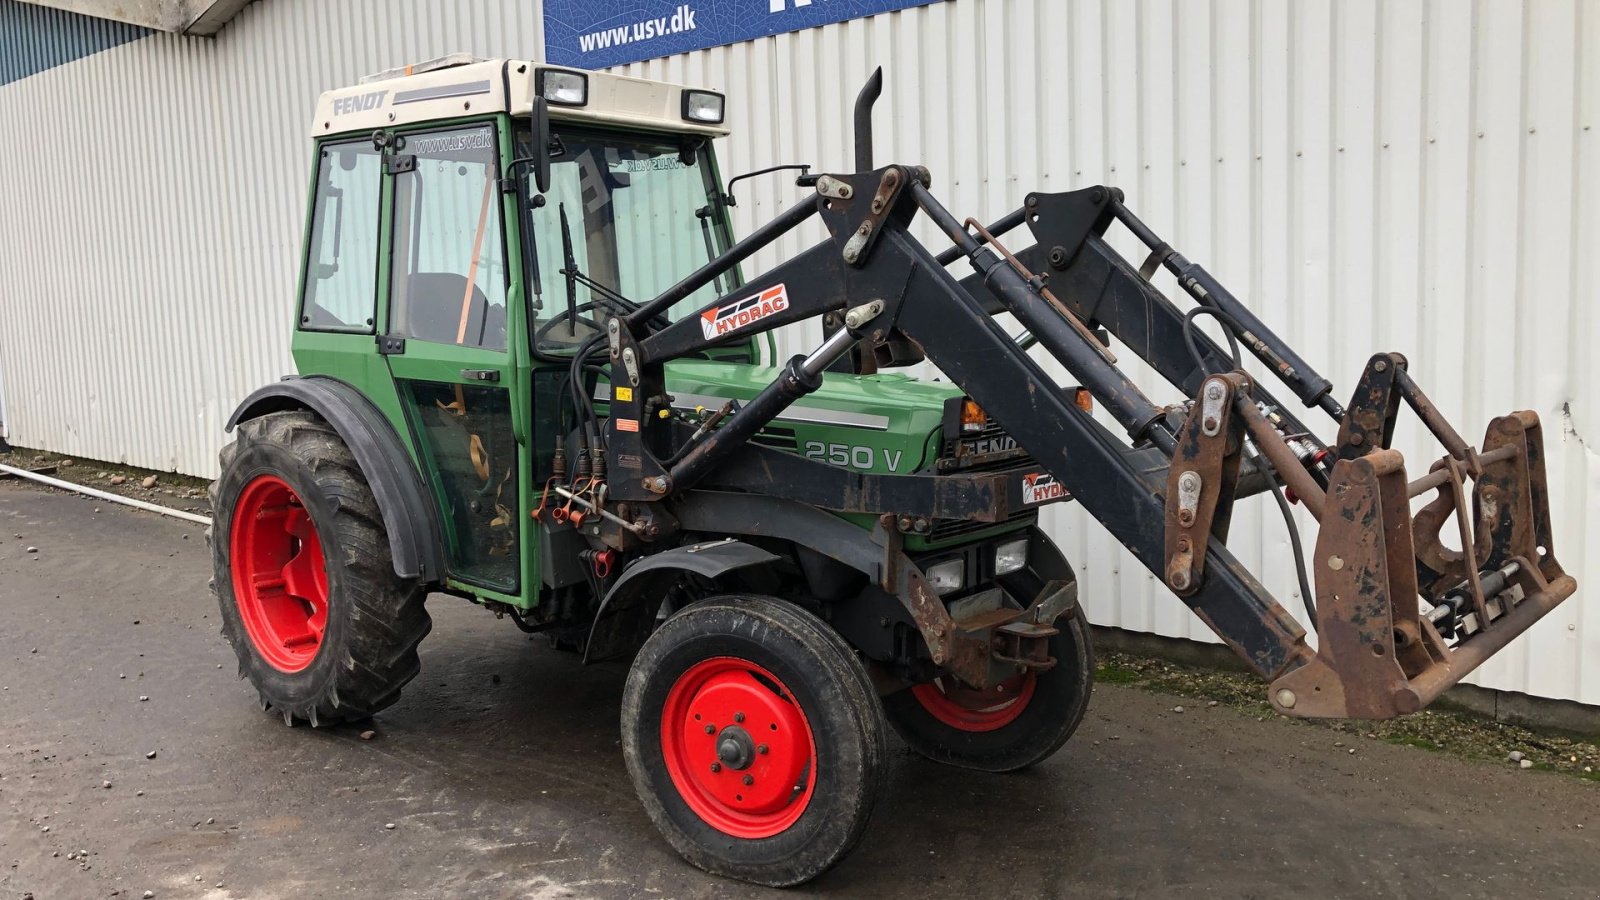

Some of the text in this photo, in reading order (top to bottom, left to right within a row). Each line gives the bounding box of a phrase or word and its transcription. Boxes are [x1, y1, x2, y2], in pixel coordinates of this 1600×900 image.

[579, 4, 697, 53] www.usv.dk
[333, 89, 389, 117] FENDT
[415, 128, 492, 153] www.usv.dk
[716, 296, 785, 335] HYDRAC
[805, 441, 902, 472] 250 V
